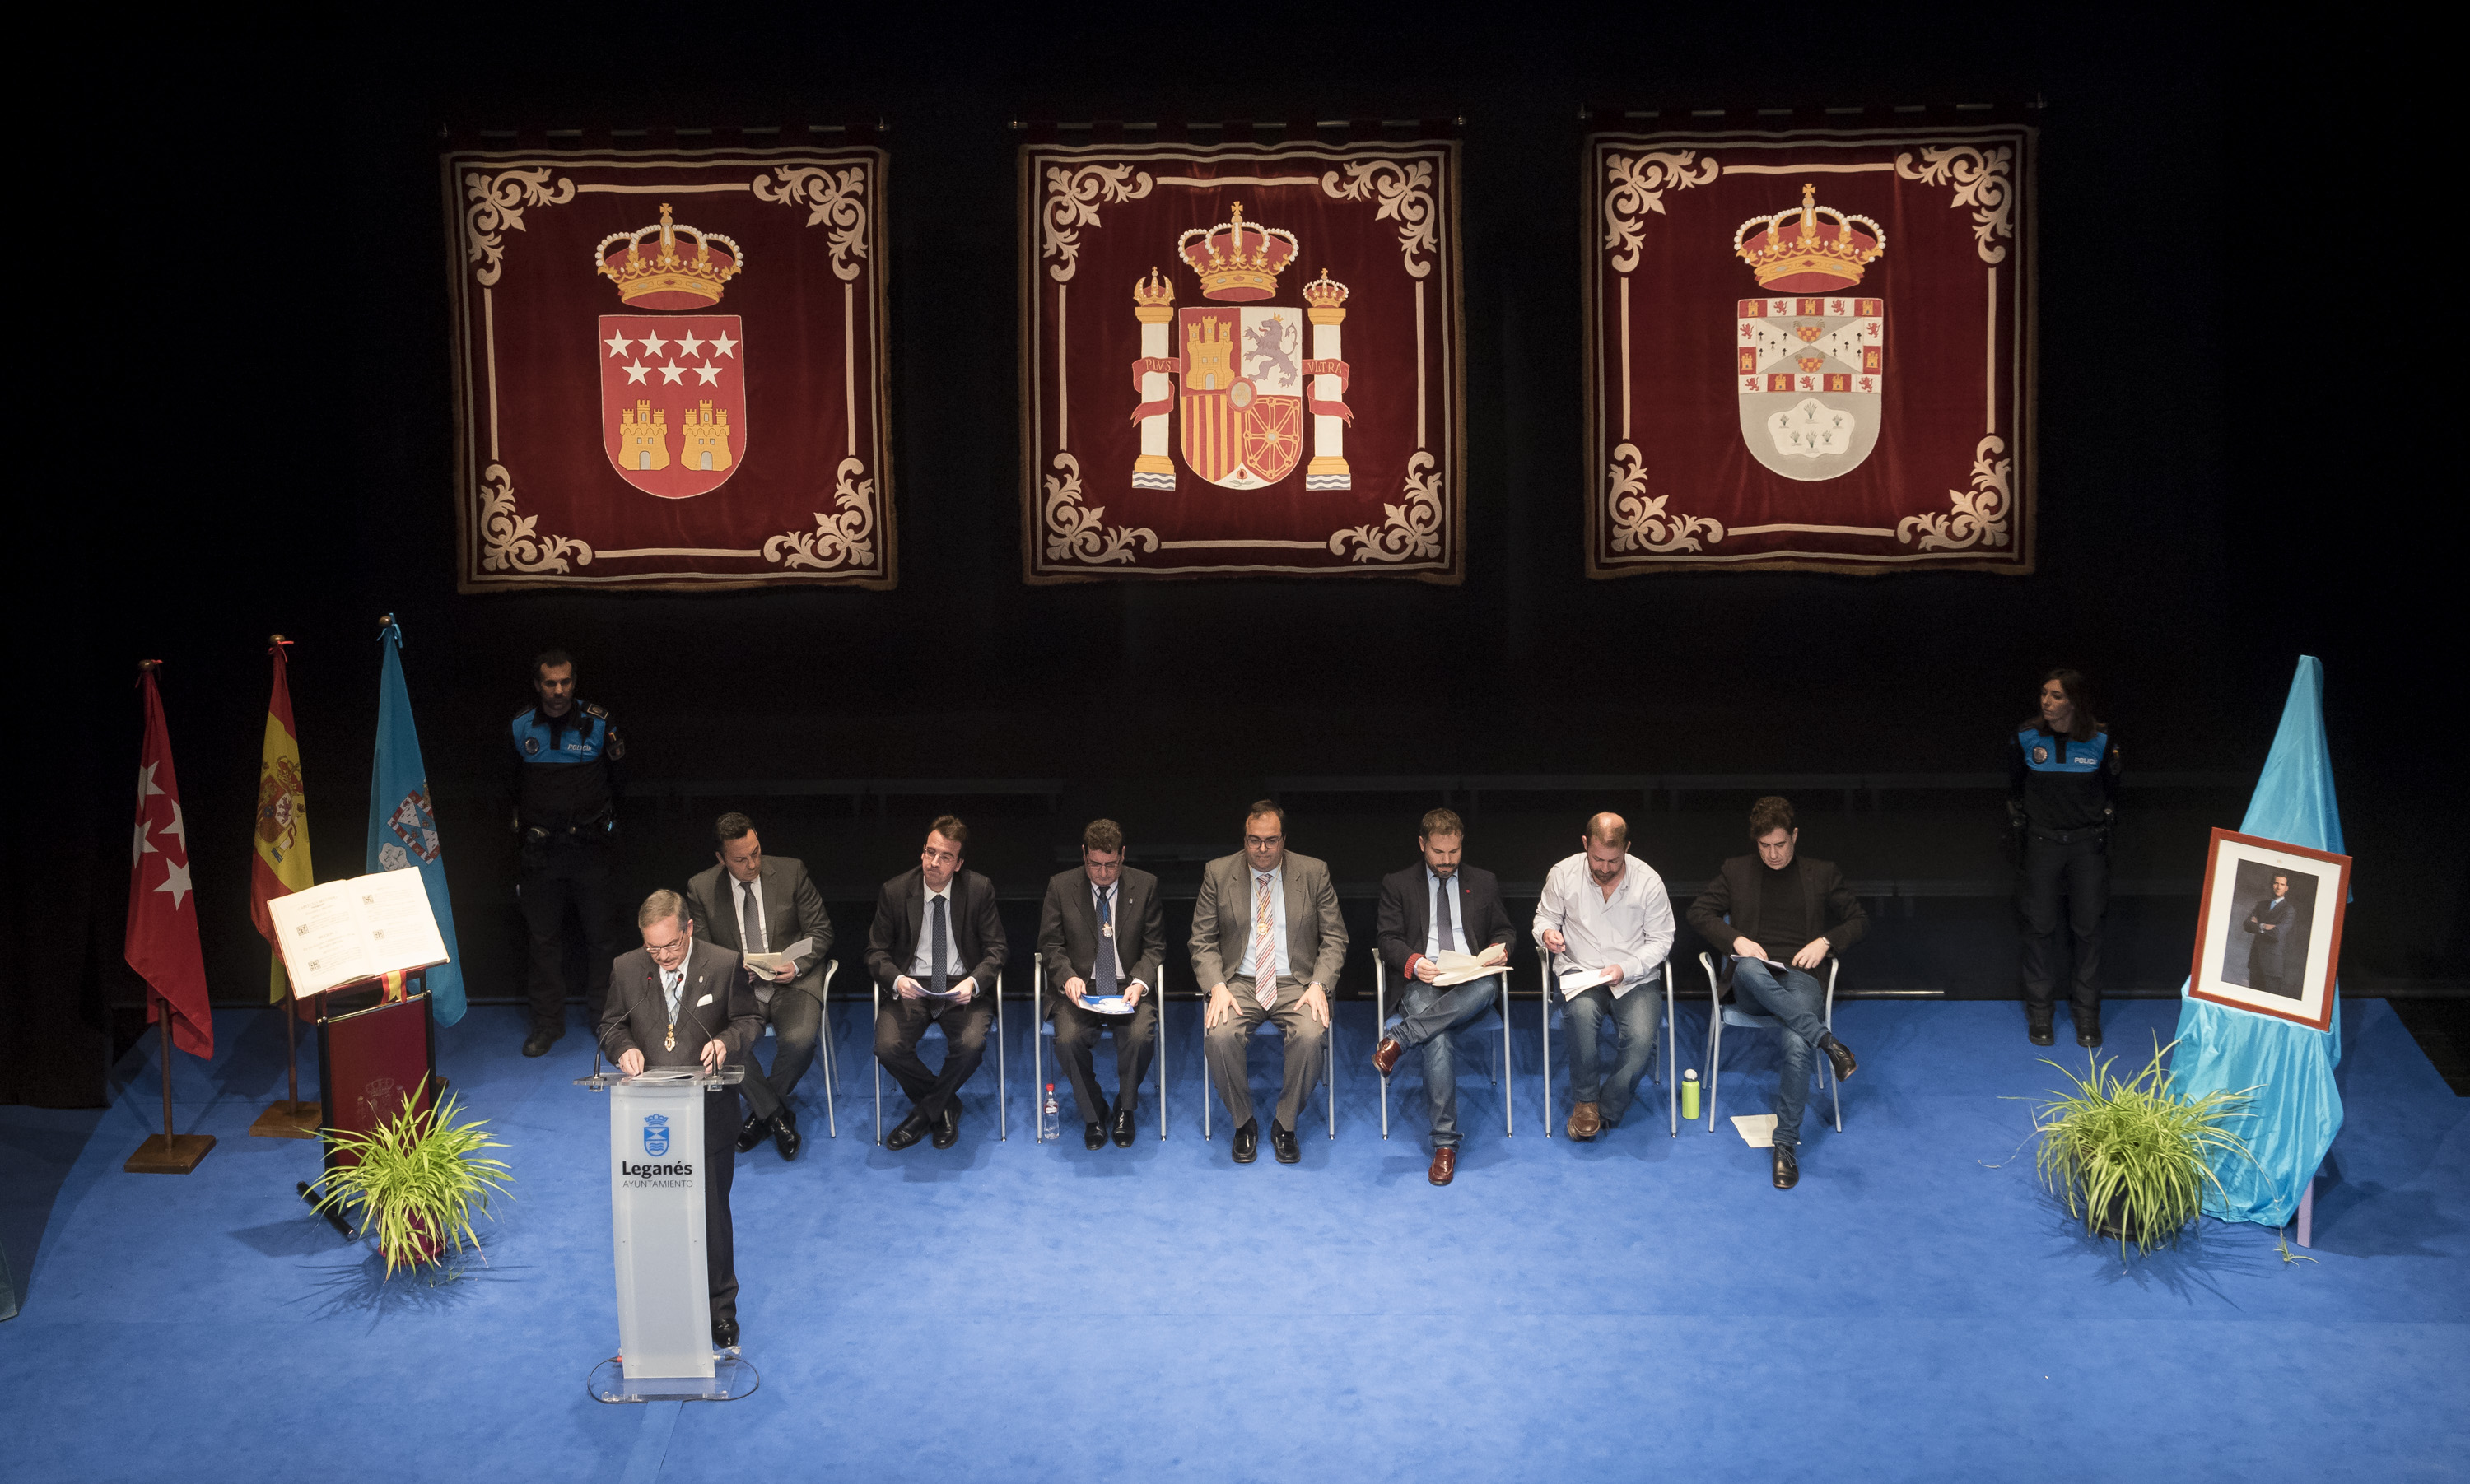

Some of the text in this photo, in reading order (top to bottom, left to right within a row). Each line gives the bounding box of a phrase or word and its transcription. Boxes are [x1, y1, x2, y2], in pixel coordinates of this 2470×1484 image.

[1145, 359, 1172, 371] PLVS
[1307, 361, 1342, 374] VLTRA
[622, 1161, 692, 1179] Leganés
[622, 1179, 693, 1188] AYUNTAMIENTO
